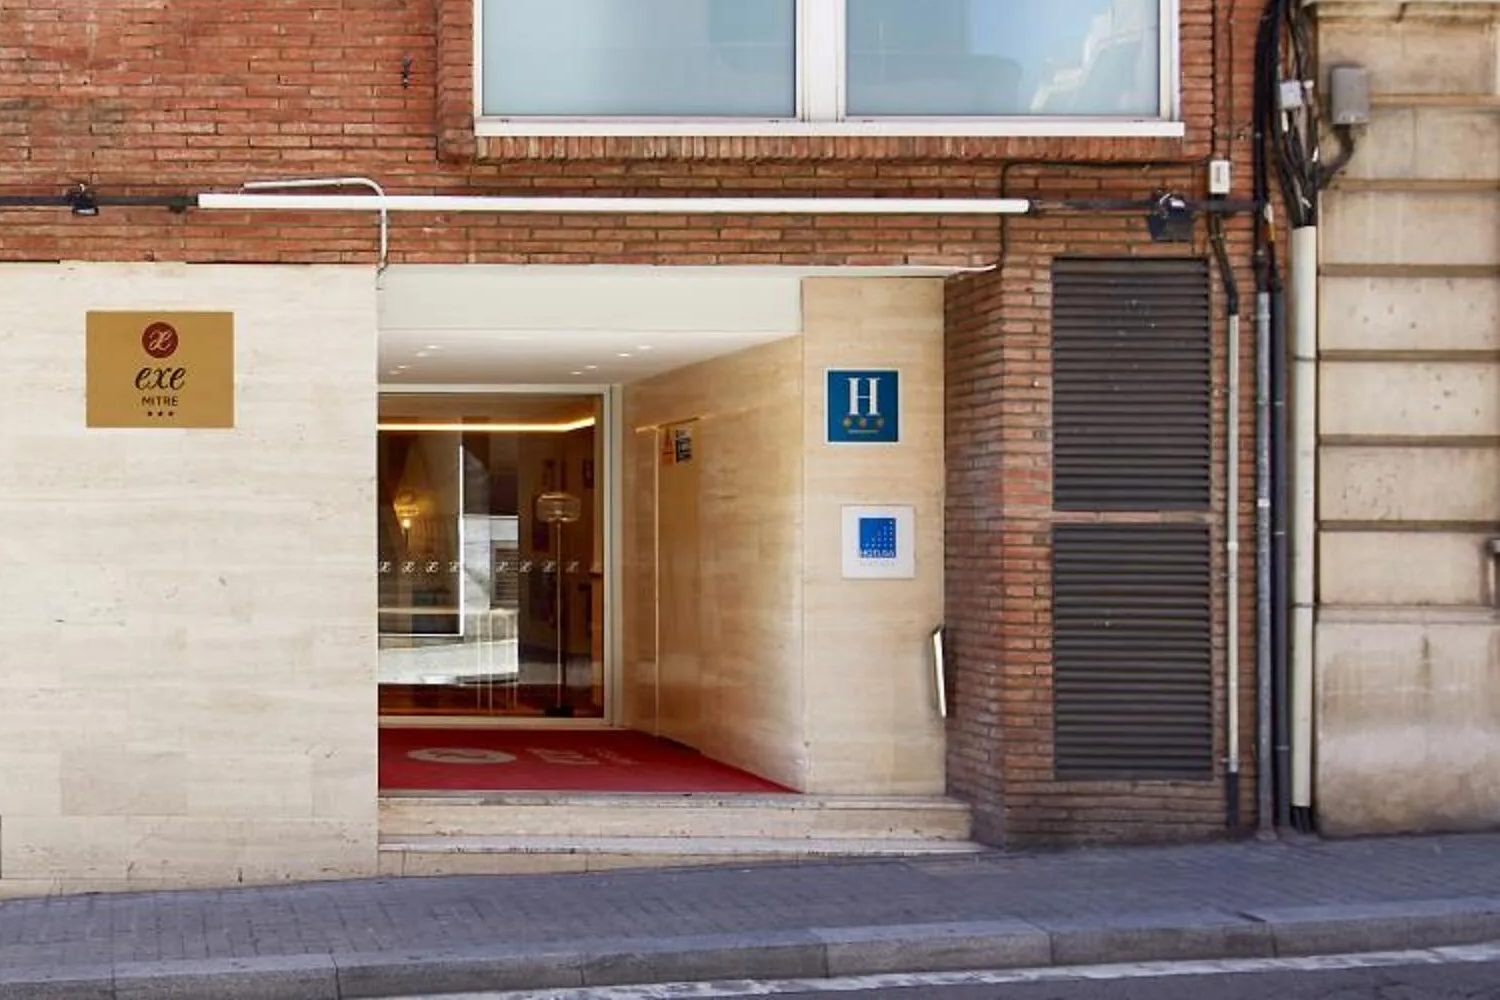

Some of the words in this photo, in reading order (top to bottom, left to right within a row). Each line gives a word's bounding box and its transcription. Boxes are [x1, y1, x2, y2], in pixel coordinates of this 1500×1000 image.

[134, 367, 187, 390] exe
[141, 396, 178, 407] MITRE
[846, 377, 881, 416] H
